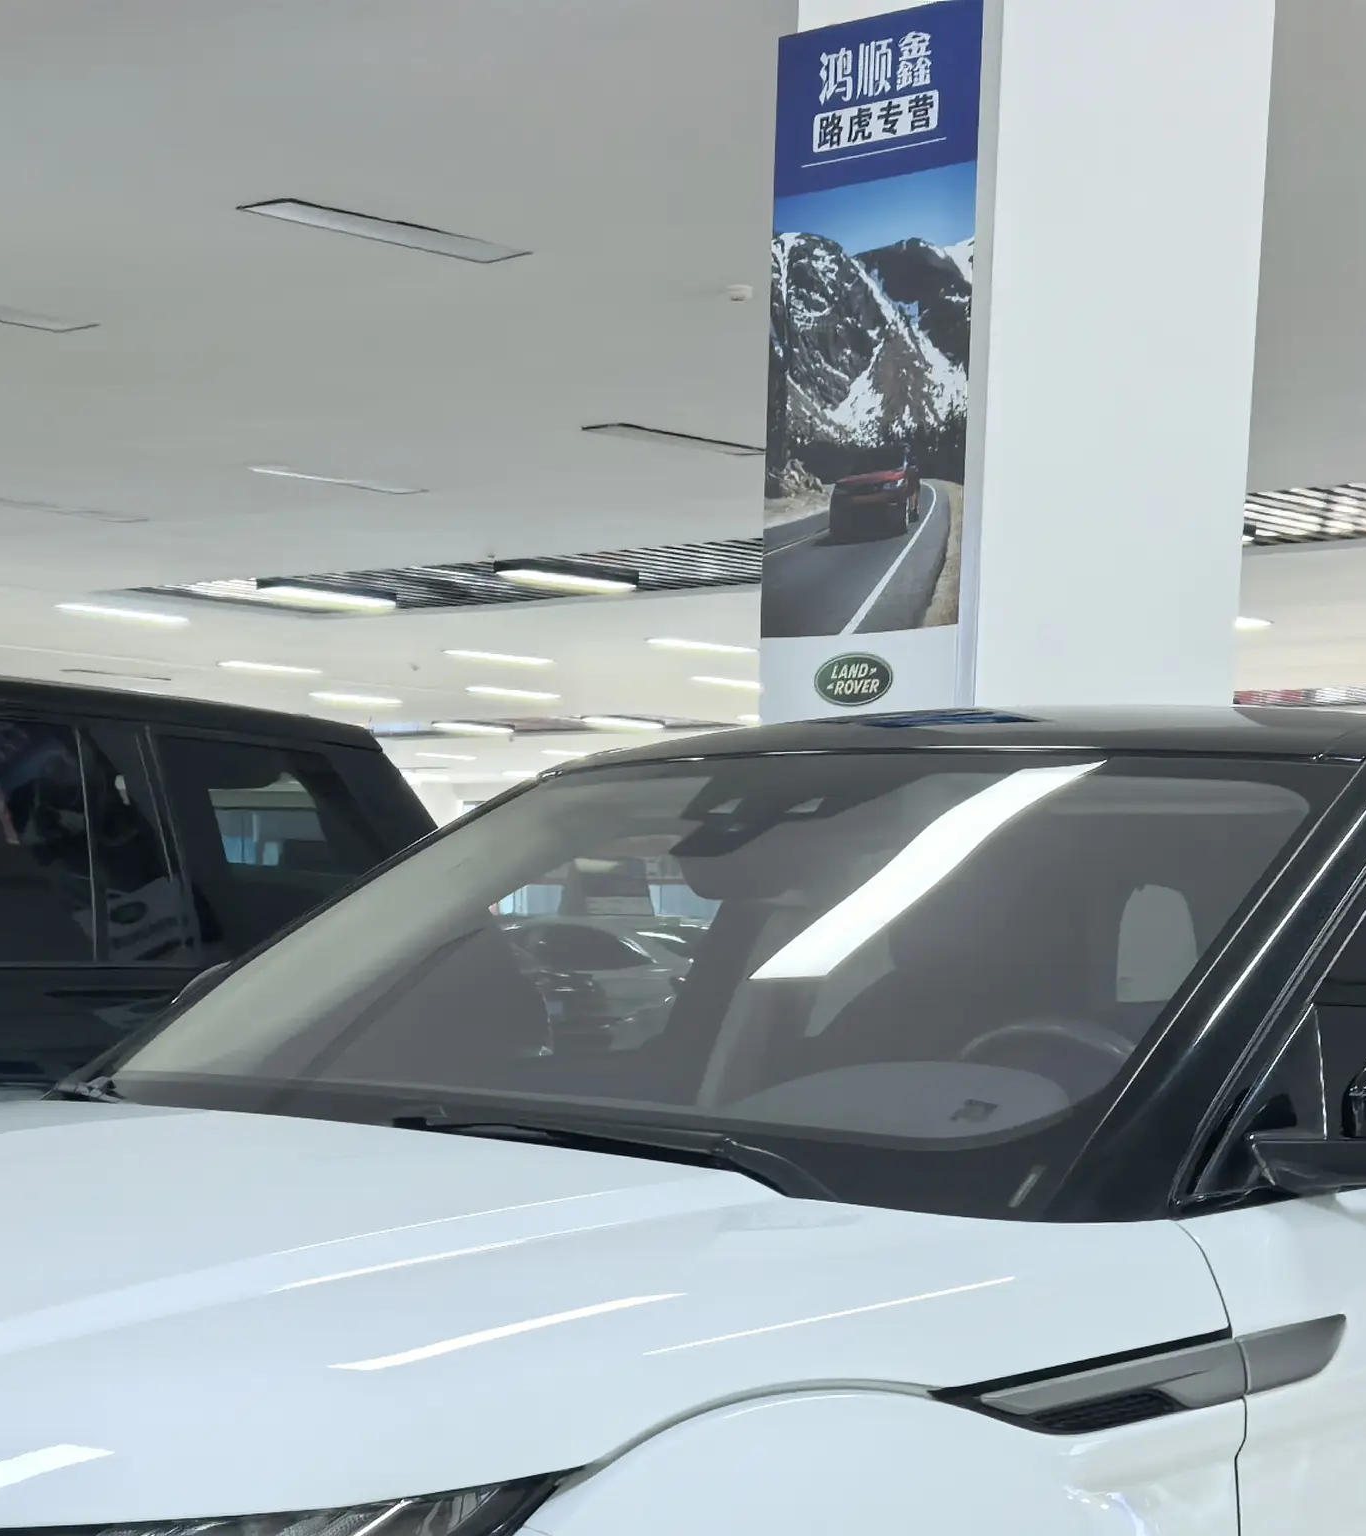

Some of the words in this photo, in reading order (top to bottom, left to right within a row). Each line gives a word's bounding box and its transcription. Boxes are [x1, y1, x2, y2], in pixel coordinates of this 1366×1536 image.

[819, 31, 932, 105] 鸿顺鑫
[817, 94, 935, 149] 路虎专营
[831, 663, 869, 679] LAND
[834, 678, 880, 695] ROVER
